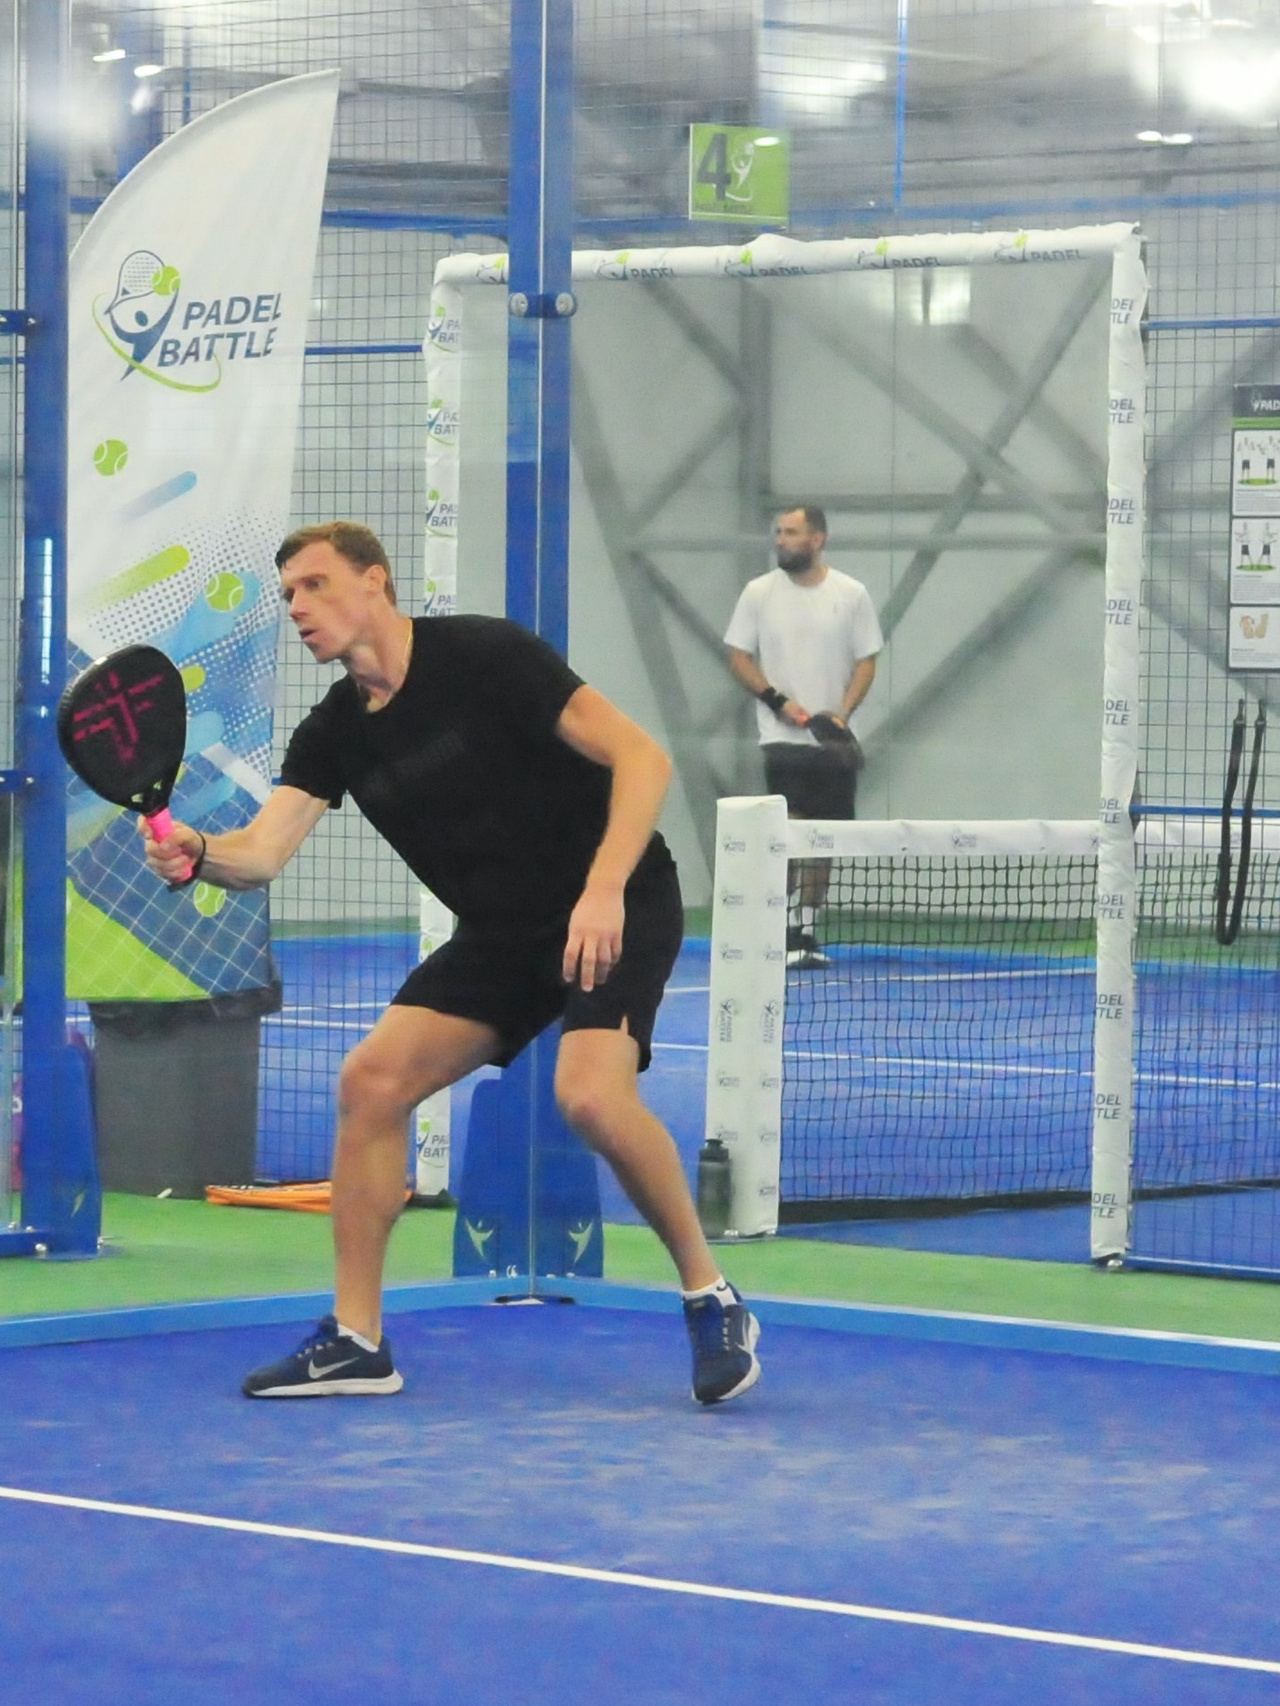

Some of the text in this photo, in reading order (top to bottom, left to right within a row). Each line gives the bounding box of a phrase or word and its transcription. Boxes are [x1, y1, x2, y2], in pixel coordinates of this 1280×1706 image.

[697, 132, 732, 201] 4
[182, 292, 282, 330] PADEL
[157, 327, 278, 367] BATTLE
[440, 503, 457, 514] PA
[437, 595, 455, 605] PA
